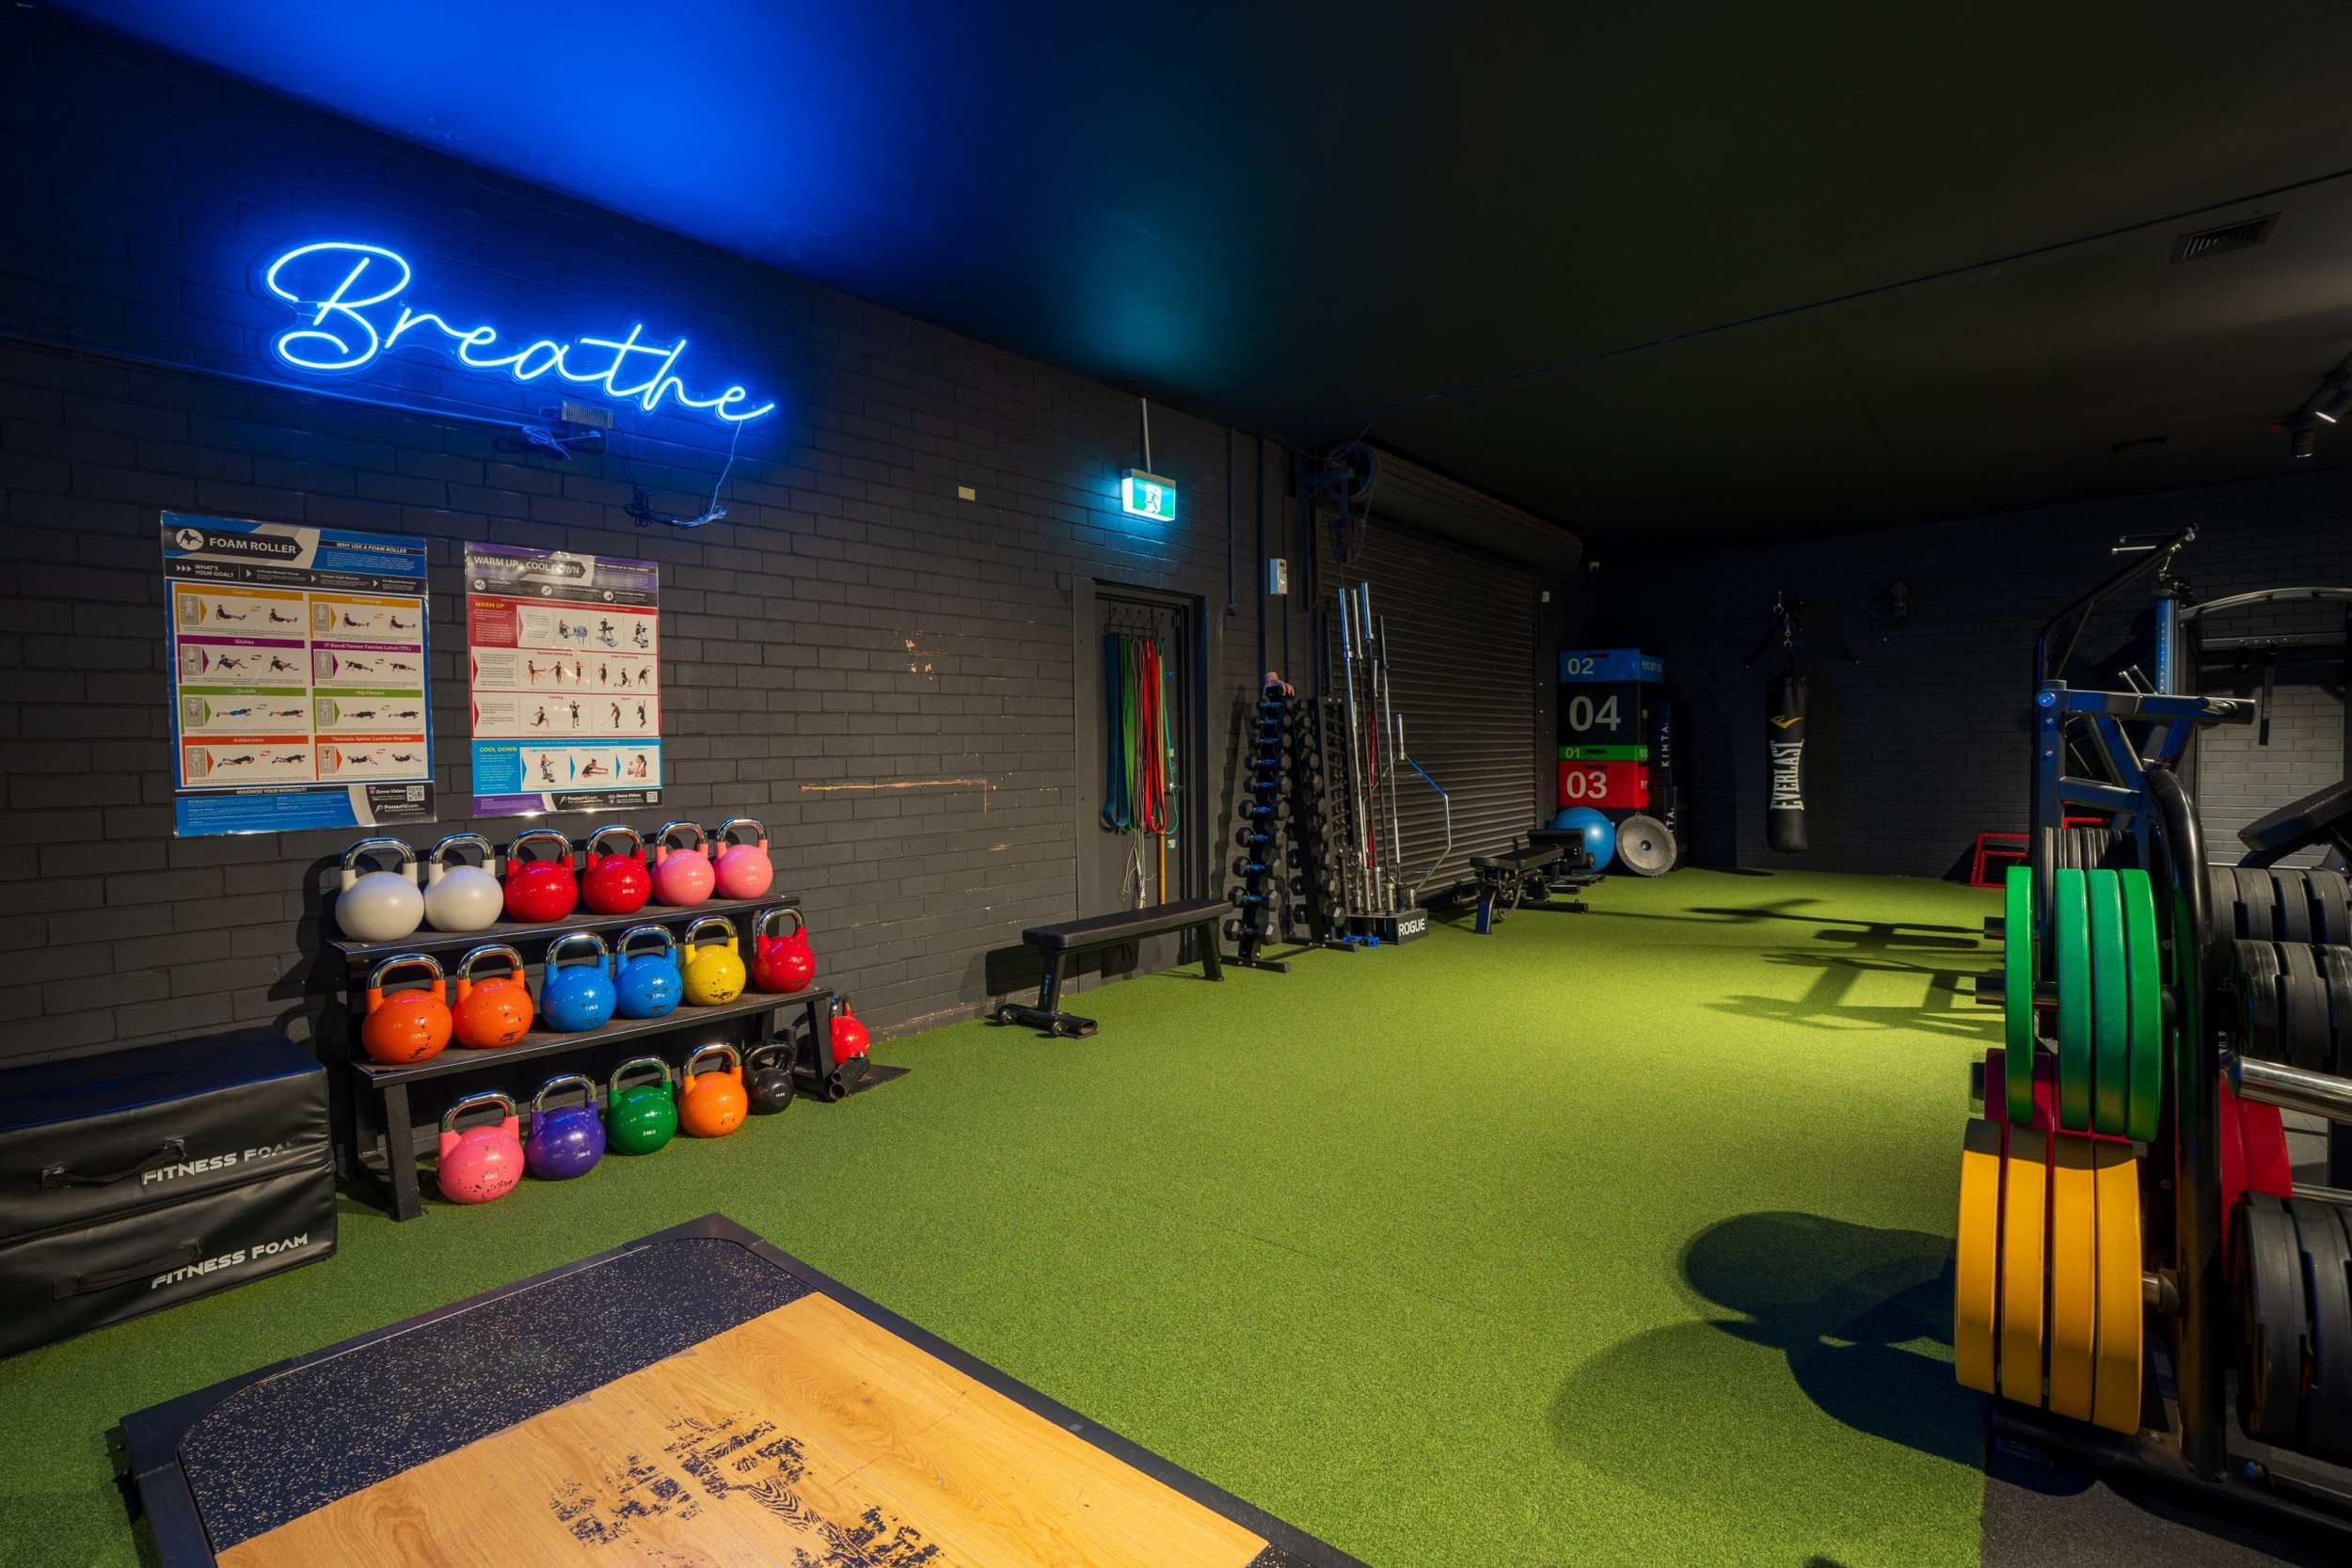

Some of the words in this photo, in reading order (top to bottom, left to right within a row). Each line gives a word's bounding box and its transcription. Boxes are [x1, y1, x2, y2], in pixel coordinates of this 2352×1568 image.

[266, 241, 775, 421] Breathe
[209, 537, 247, 549] FOAM
[250, 542, 296, 554] ROLLER
[473, 556, 504, 566] WARM
[505, 559, 518, 568] UP
[526, 561, 550, 572] COOL
[551, 563, 580, 574] DOWN
[1566, 657, 1595, 675] 02
[1568, 694, 1622, 732] 04
[1565, 747, 1581, 759] 01
[1565, 770, 1608, 800] 03
[1769, 738, 1804, 811] EVERLAST
[1398, 918, 1425, 937] ROGUE
[142, 1151, 238, 1186] FITNESS
[151, 1249, 246, 1290] FITNESS
[251, 1232, 308, 1259] FOAM
